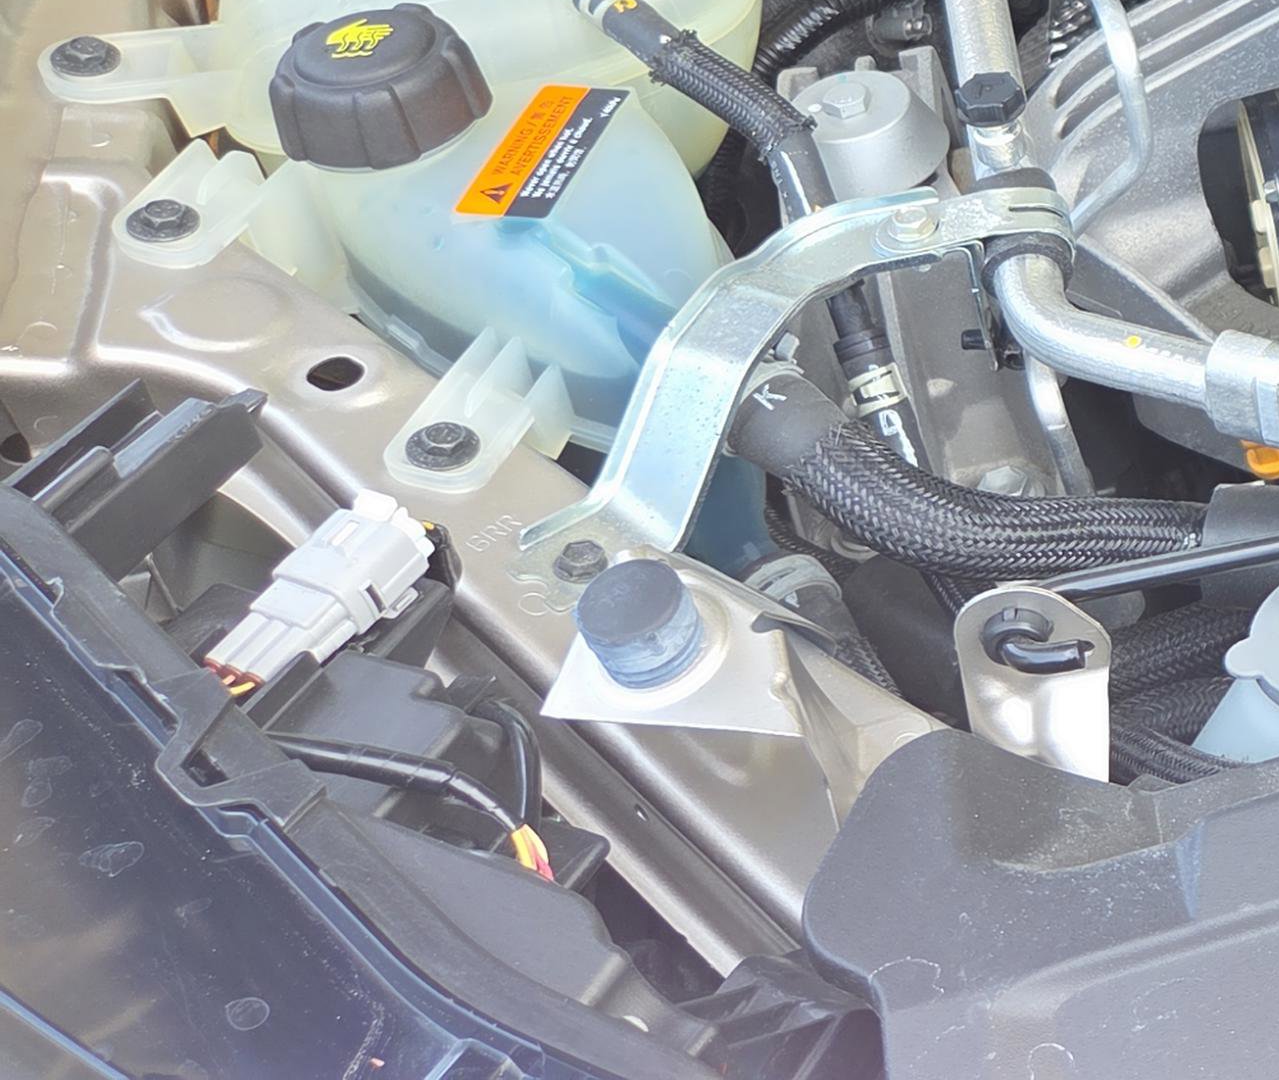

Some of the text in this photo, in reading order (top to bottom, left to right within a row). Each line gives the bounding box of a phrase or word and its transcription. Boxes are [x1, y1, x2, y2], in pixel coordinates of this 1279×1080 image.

[492, 128, 533, 174] WARNING
[509, 96, 573, 175] AVERTISSEMENT
[753, 383, 788, 411] K
